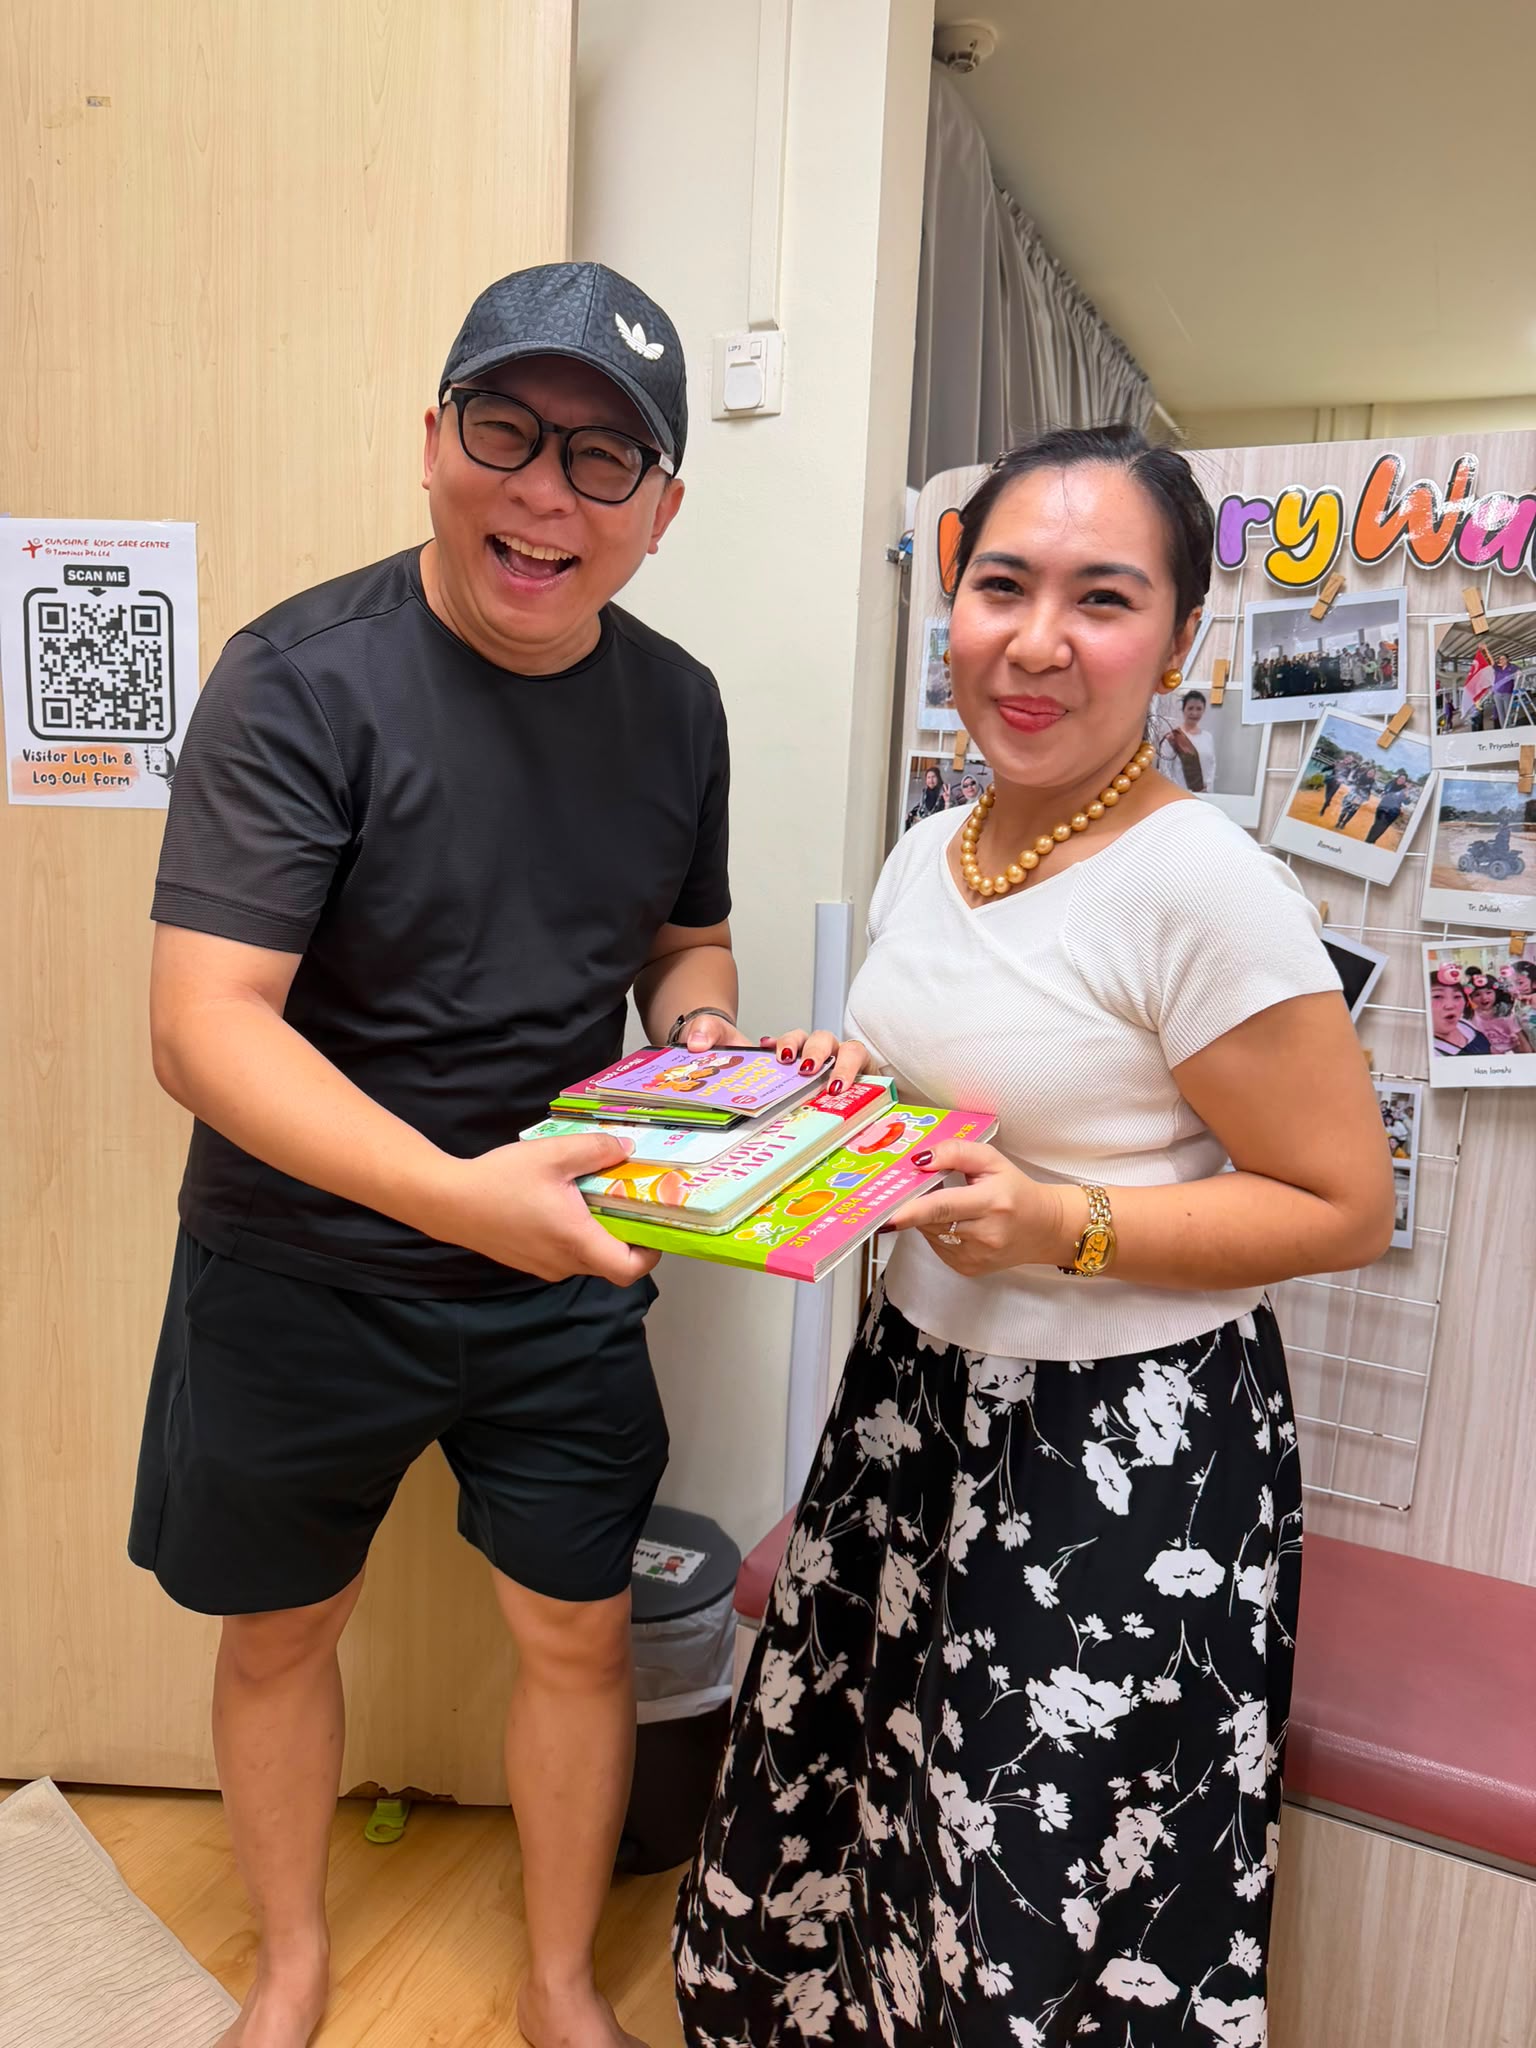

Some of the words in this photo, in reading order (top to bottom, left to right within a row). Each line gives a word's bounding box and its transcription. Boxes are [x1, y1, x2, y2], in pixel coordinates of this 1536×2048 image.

[1352, 453, 1536, 573] Wa
[44, 538, 89, 547] SUNSHINE
[94, 539, 115, 547] KIDS
[117, 540, 139, 548] CARE
[140, 541, 171, 549] CENTRE
[67, 570, 103, 582] SCAN
[105, 571, 126, 583] ME
[22, 749, 68, 763] Visitor
[123, 752, 133, 765] &
[696, 1056, 772, 1097] Champion
[723, 1143, 786, 1181] LOVE
